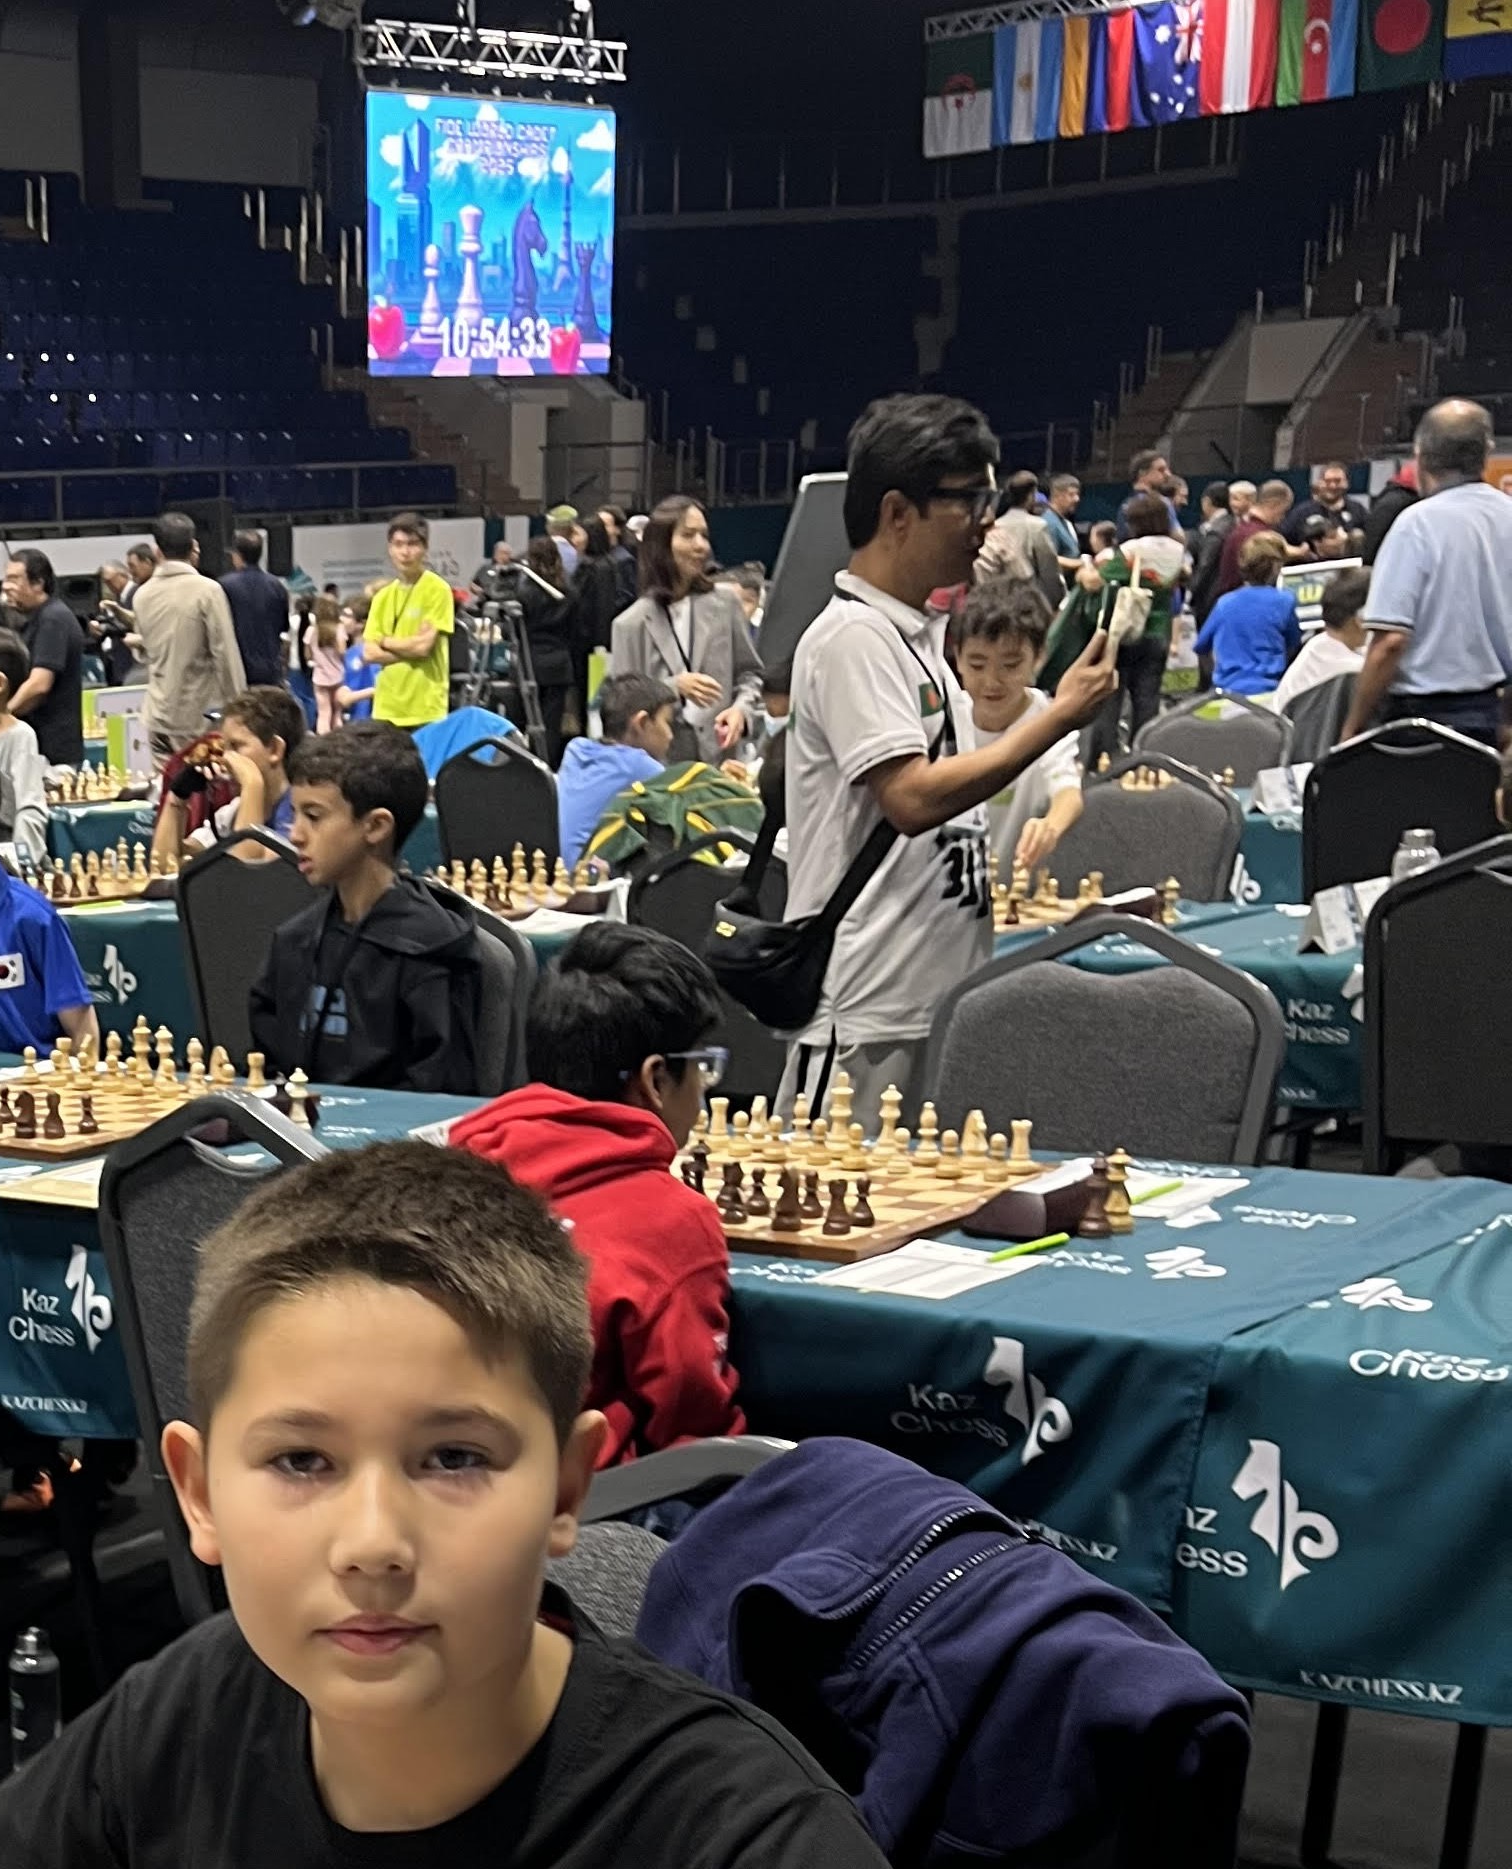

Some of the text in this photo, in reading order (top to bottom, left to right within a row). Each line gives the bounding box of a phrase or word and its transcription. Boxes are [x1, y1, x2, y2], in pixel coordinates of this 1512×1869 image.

[440, 317, 552, 358] 10:54:33
[1284, 1023, 1350, 1045] hess
[21, 1287, 59, 1317] Kaz
[7, 1314, 75, 1348] Chess
[907, 1383, 977, 1412] Kaz
[1175, 1543, 1249, 1577] ess
